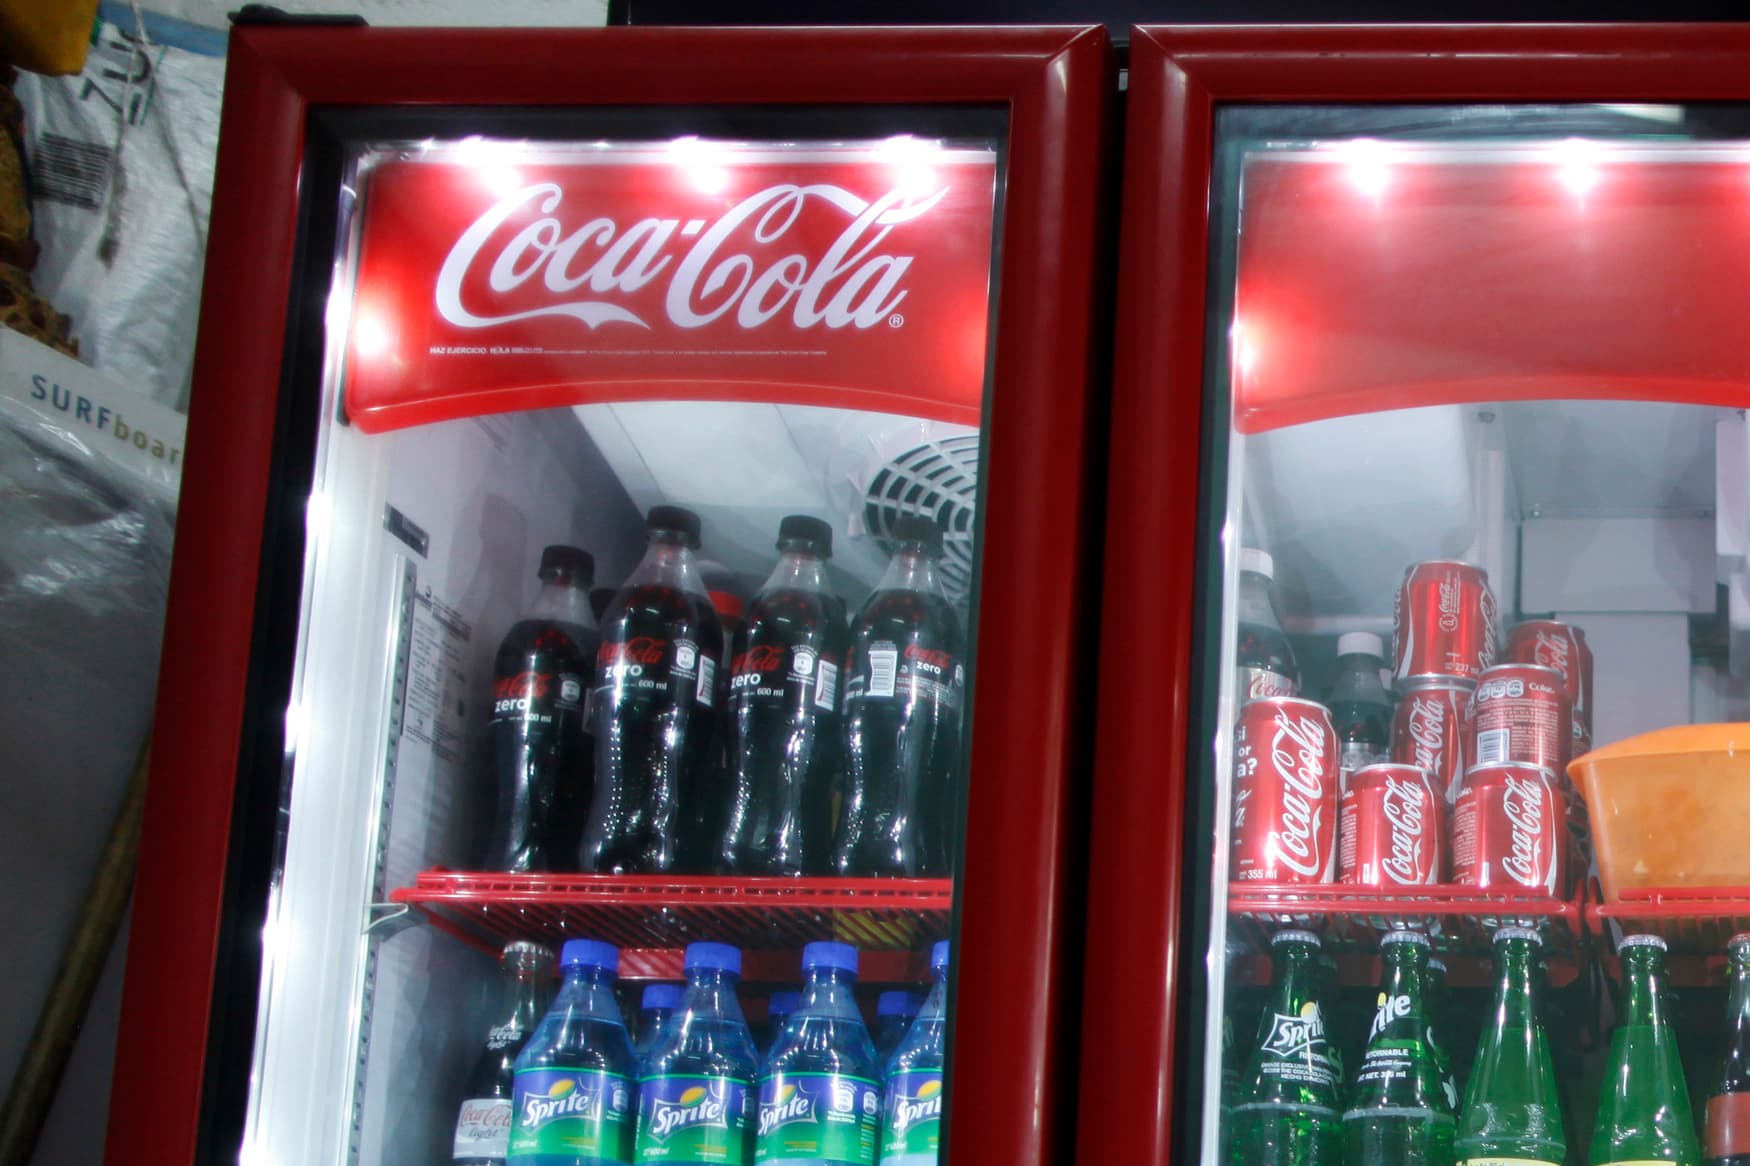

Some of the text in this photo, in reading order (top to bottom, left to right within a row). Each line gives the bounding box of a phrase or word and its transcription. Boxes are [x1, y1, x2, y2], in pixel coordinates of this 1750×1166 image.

[435, 182, 950, 330] Coca-Cola
[31, 373, 180, 464] SURFboar
[605, 664, 642, 679] zero
[730, 672, 761, 689] zero
[916, 660, 941, 674] zero
[494, 698, 528, 713] zero
[1270, 707, 1326, 877] Coca-Cola
[1382, 774, 1423, 885] Coca-Cola
[1502, 772, 1543, 886] Coca-Cola
[522, 1089, 590, 1127] Sprite
[653, 1092, 721, 1134] Sprite
[758, 1091, 809, 1136] Sprite
